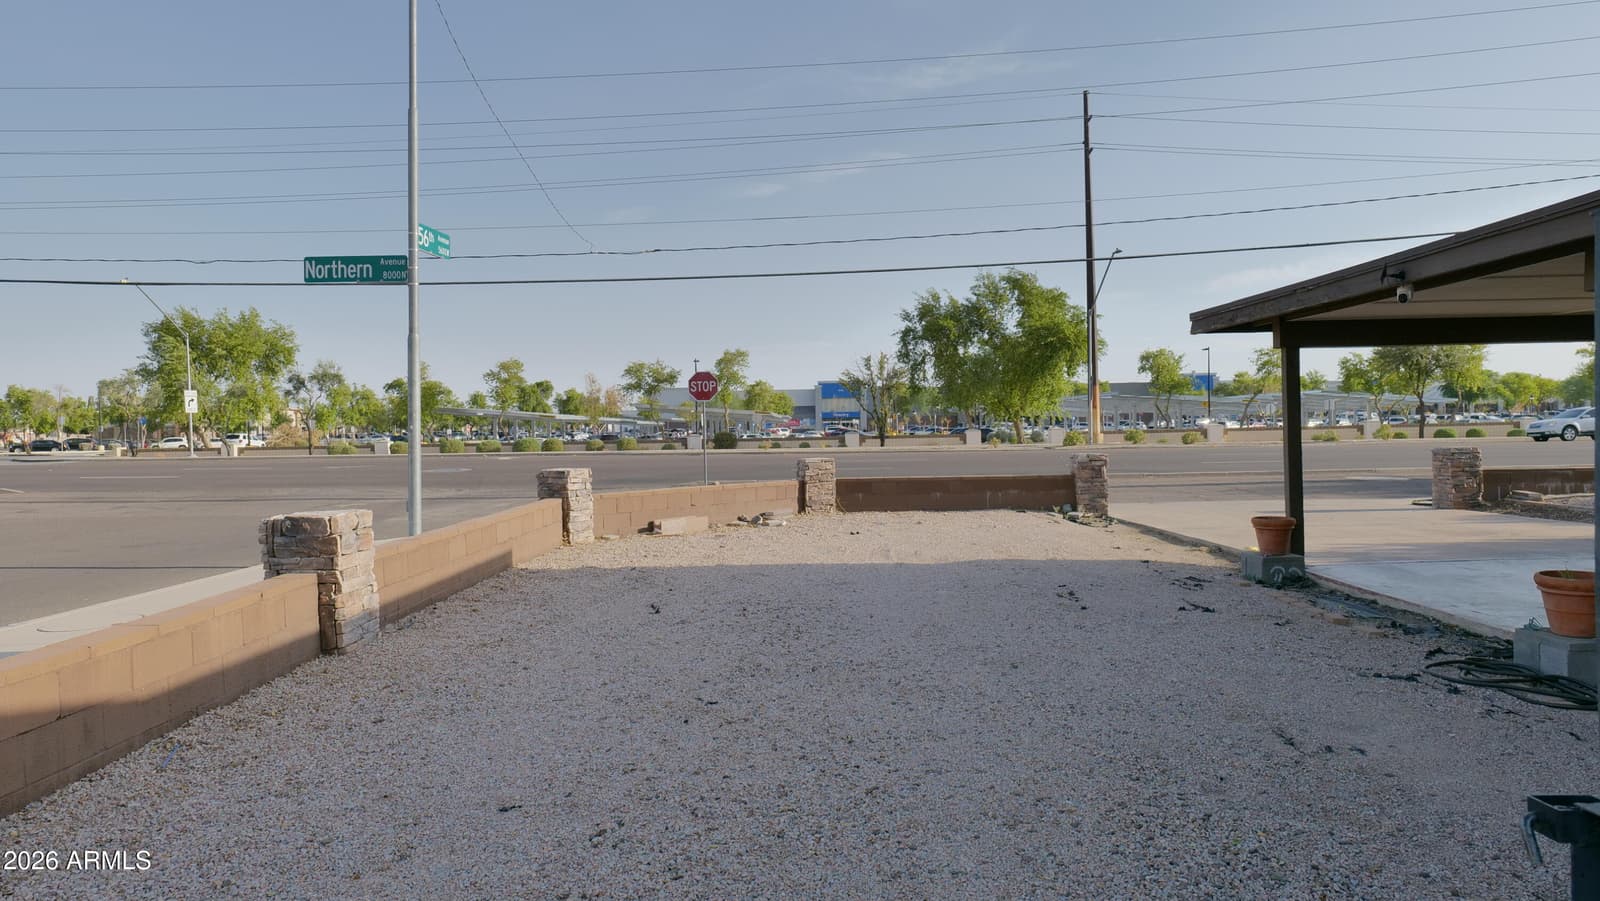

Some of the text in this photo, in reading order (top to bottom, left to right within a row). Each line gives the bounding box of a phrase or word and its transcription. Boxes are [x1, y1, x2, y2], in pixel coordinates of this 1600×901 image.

[418, 226, 435, 248] 56th
[380, 257, 406, 266] Avenue
[305, 260, 373, 279] Northern
[690, 380, 716, 392] STOP
